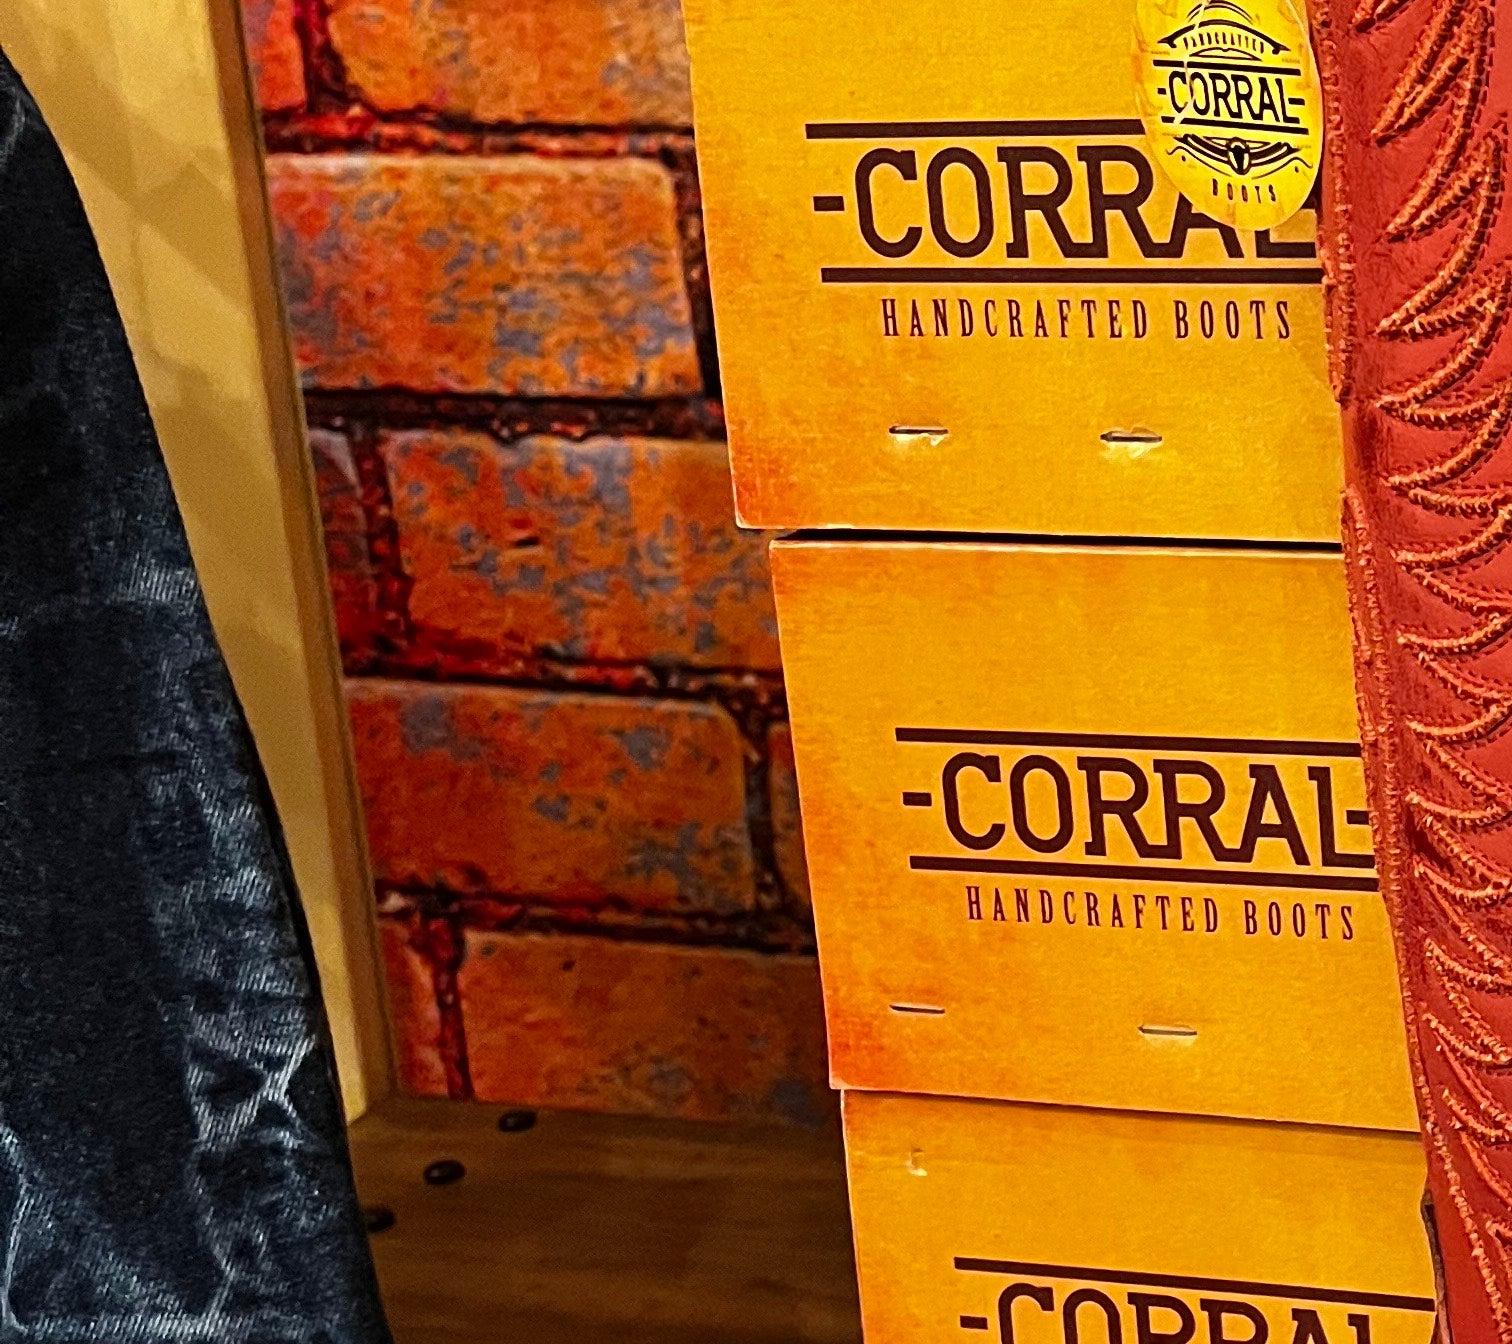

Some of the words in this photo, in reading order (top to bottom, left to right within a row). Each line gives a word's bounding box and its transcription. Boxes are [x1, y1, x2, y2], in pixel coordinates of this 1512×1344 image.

[1212, 178, 1277, 204] BOOTS
[881, 298, 1148, 339] HANDCRAFTED
[1175, 300, 1291, 340] BOOTS
[966, 885, 1218, 933] HANDCRAFTED
[1244, 900, 1354, 940] BOOTS
